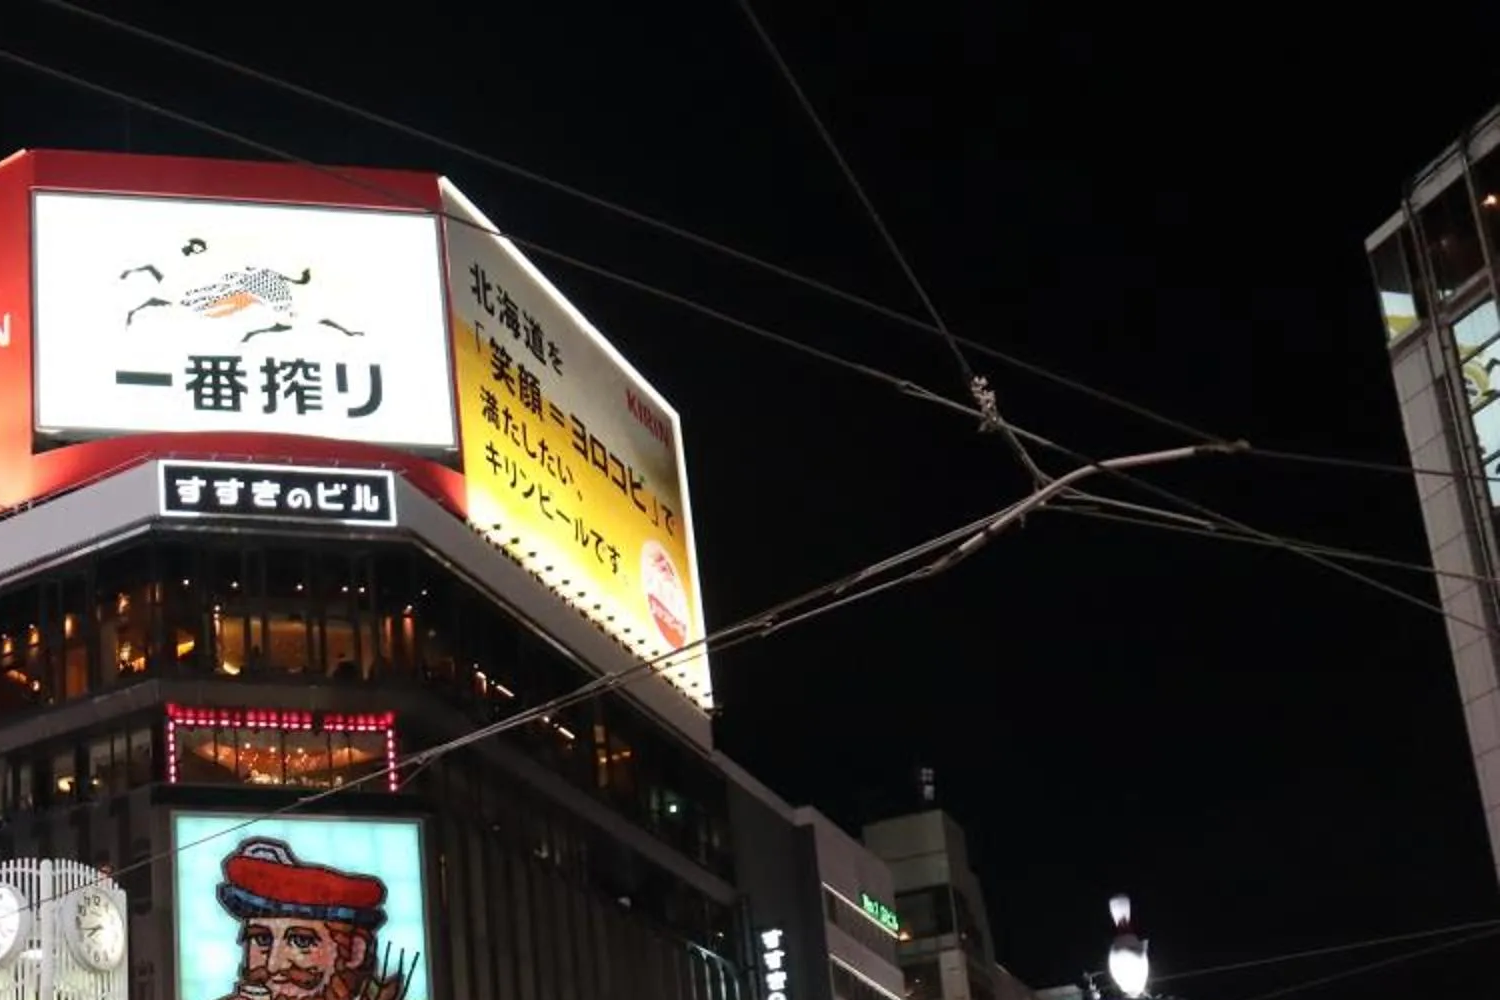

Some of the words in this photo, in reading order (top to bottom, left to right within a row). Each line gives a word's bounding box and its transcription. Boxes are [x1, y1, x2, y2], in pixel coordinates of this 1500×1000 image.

[470, 262, 564, 376] 北海道を
[114, 352, 385, 418] 一番搾り
[624, 387, 674, 448] KIRIN
[174, 475, 380, 514] すすきのビル
